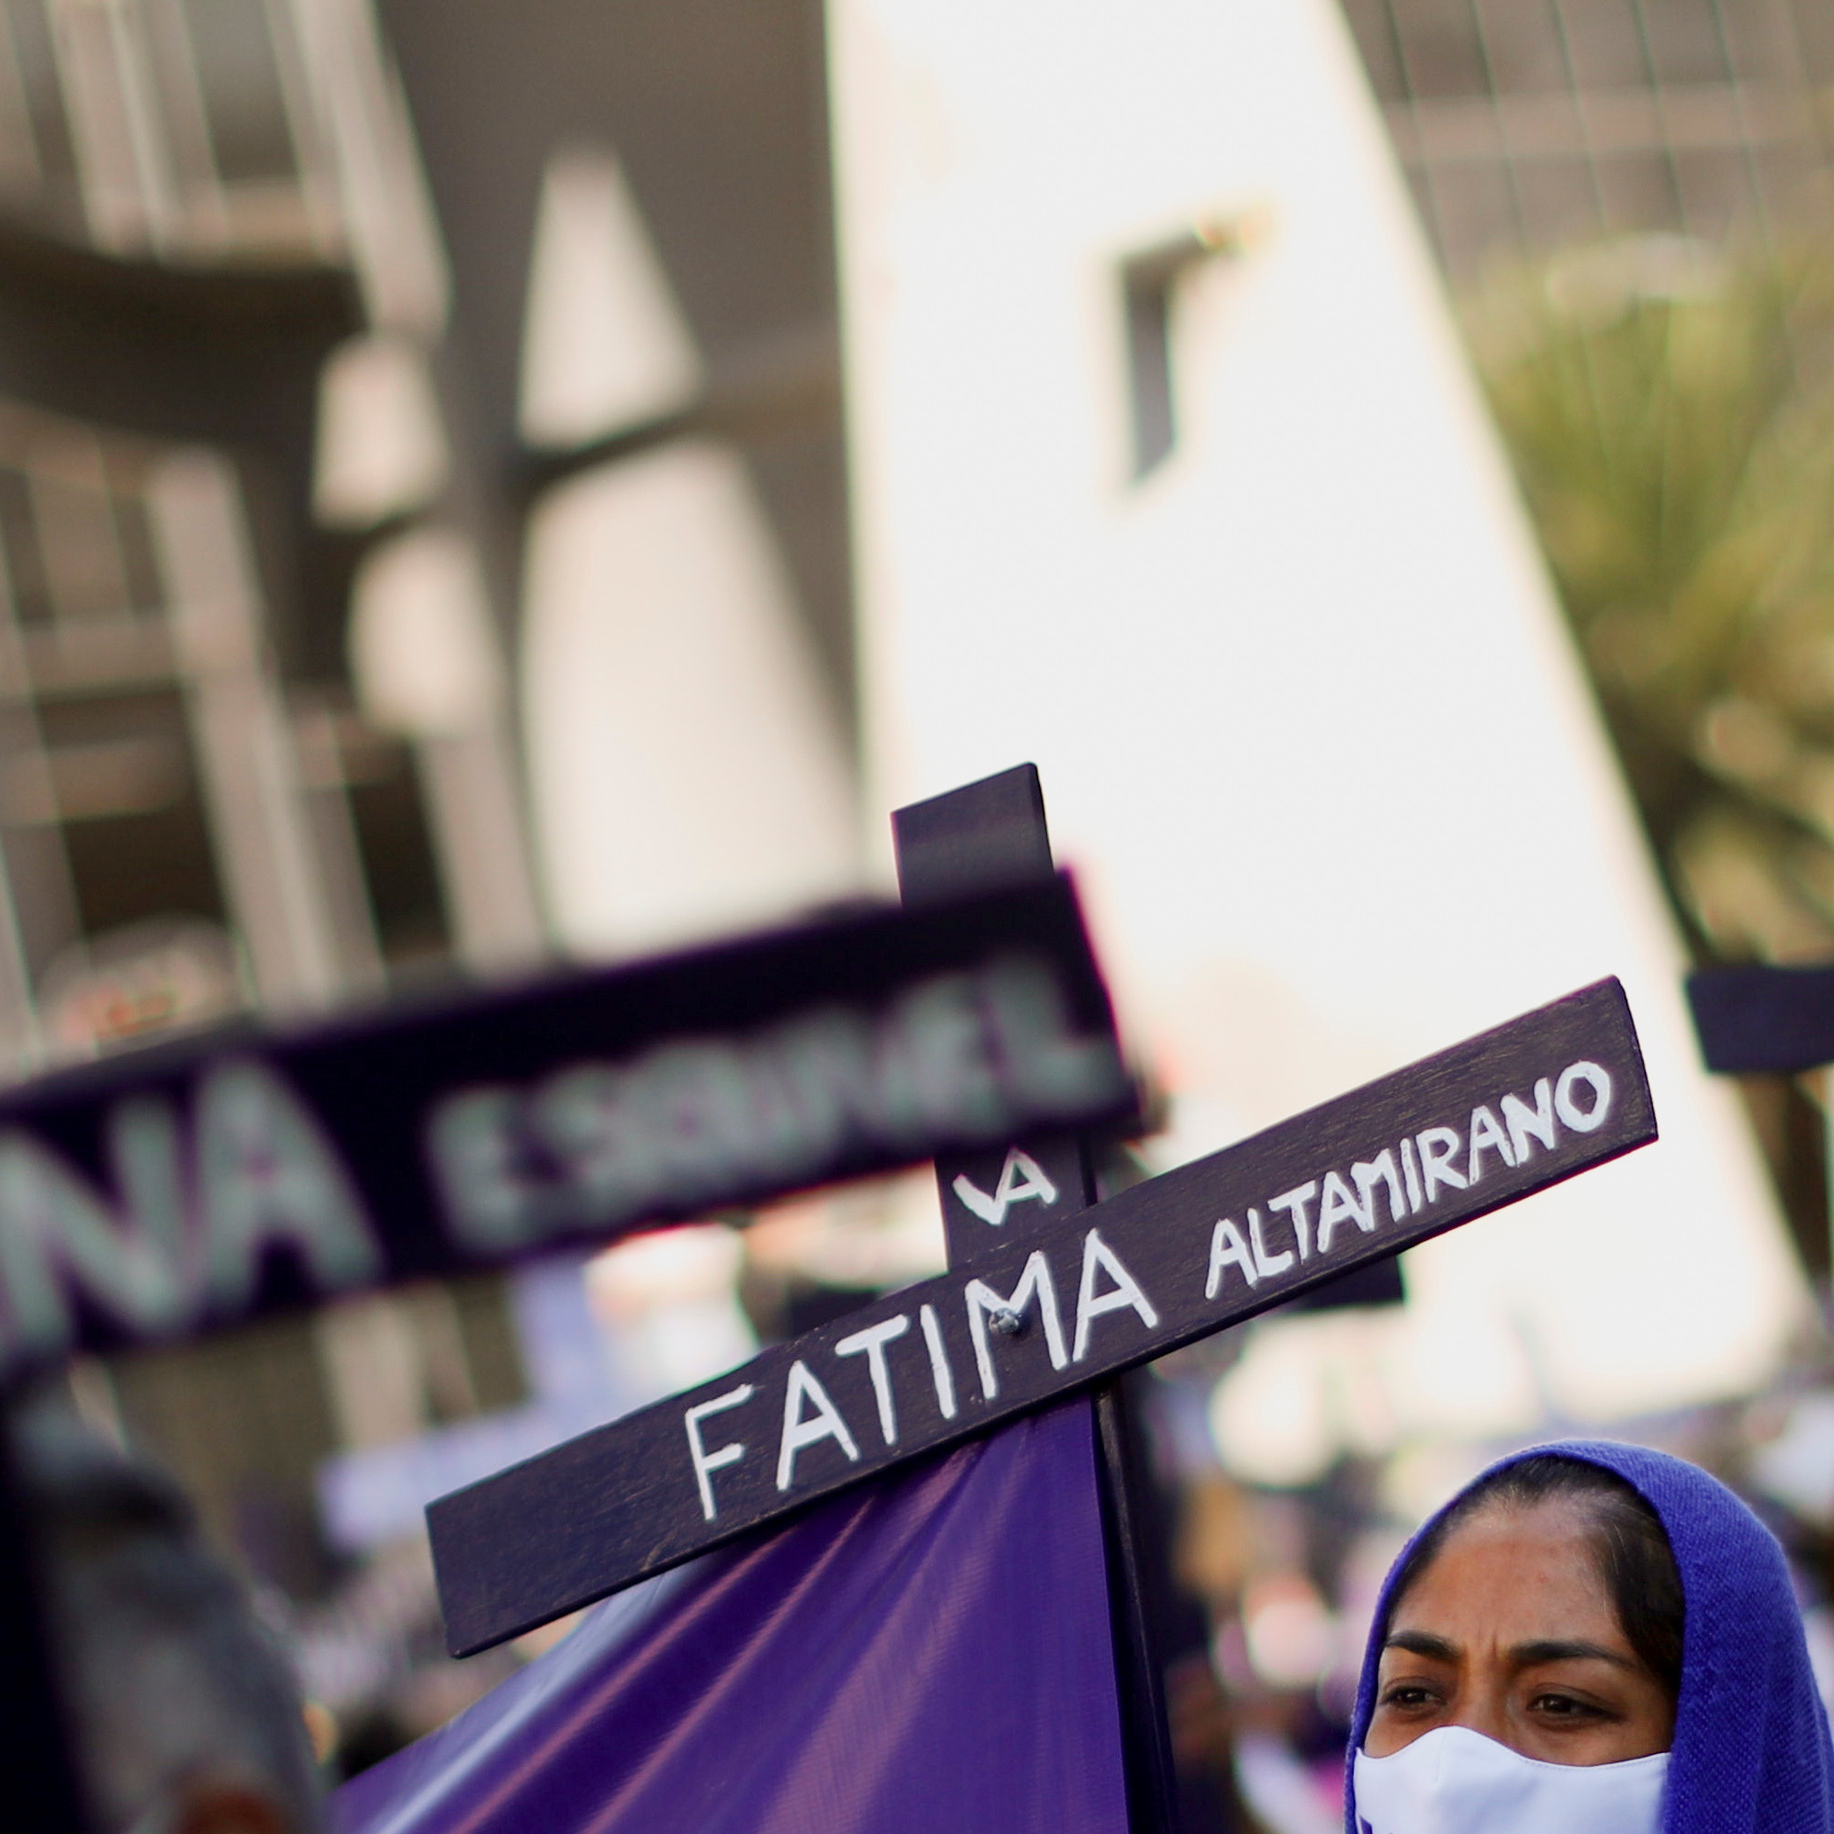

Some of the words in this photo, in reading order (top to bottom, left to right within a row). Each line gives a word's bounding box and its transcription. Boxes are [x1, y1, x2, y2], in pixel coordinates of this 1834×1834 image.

[684, 1231, 1159, 1520] FATIMA
[1205, 1059, 1611, 1299] ALTAMIRANO
[954, 1147, 1056, 1226] VA
